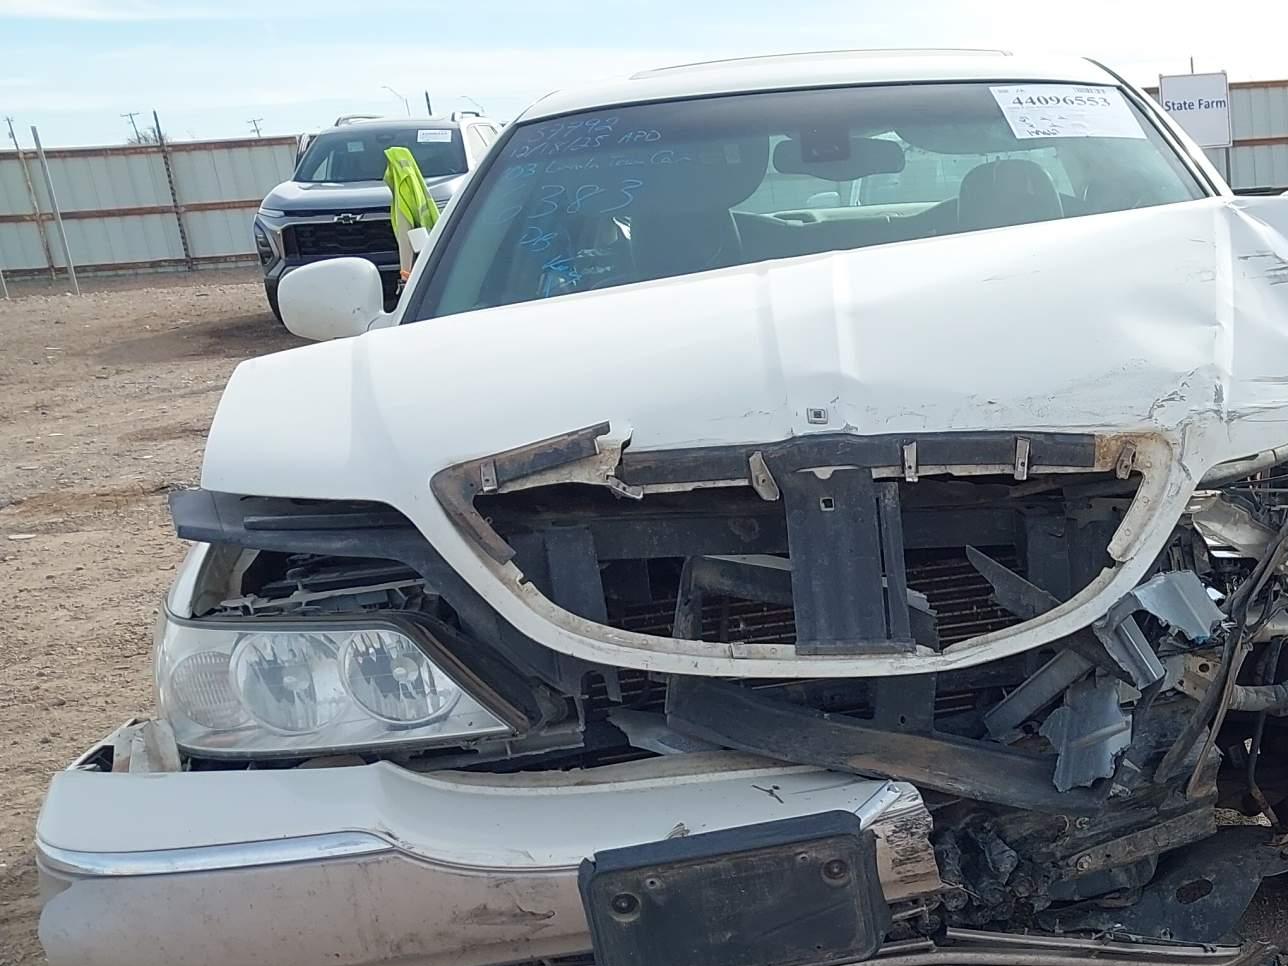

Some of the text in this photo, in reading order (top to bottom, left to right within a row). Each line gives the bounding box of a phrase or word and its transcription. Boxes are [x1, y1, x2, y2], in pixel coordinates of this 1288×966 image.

[1012, 95, 1111, 107] 44096553
[1164, 98, 1227, 112] State Farm
